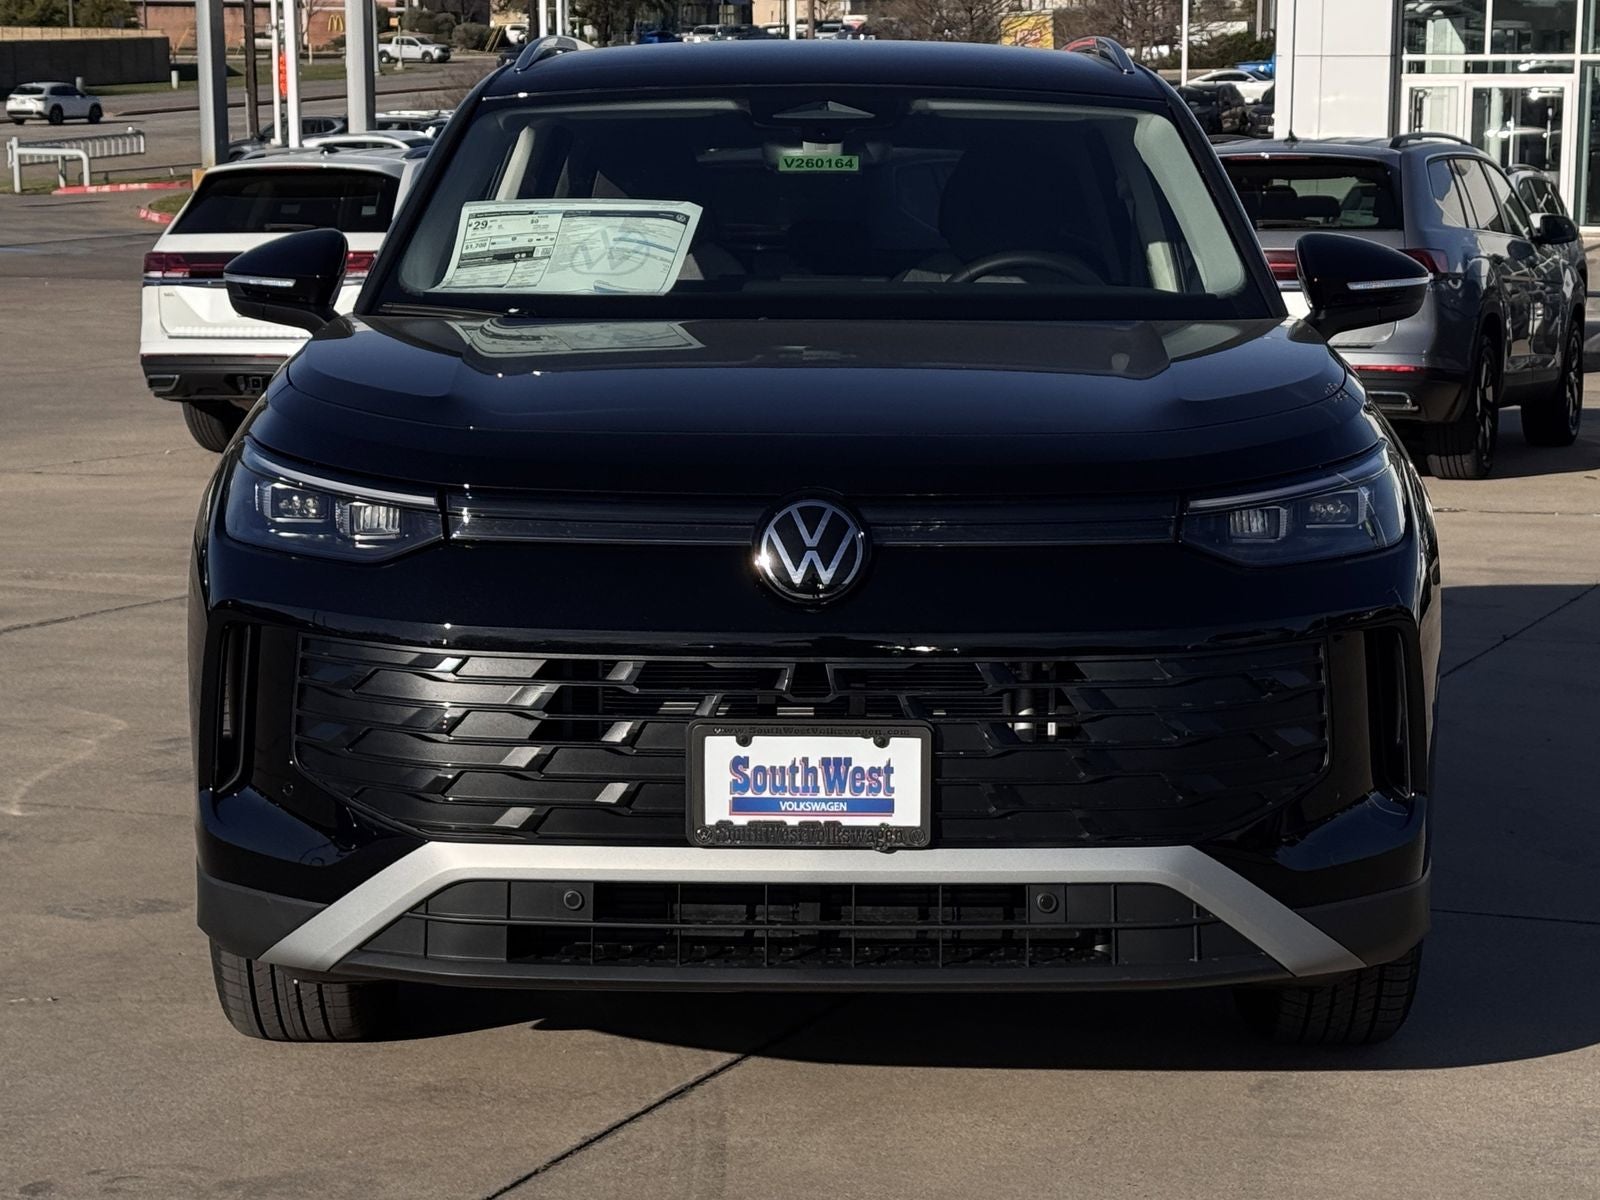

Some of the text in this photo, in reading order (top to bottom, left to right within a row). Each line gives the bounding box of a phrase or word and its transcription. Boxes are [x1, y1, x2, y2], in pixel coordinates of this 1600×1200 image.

[783, 158, 854, 169] V260164
[473, 220, 489, 230] 29
[729, 755, 895, 796] SouthWest
[779, 801, 847, 811] VOLKSWAGEN
